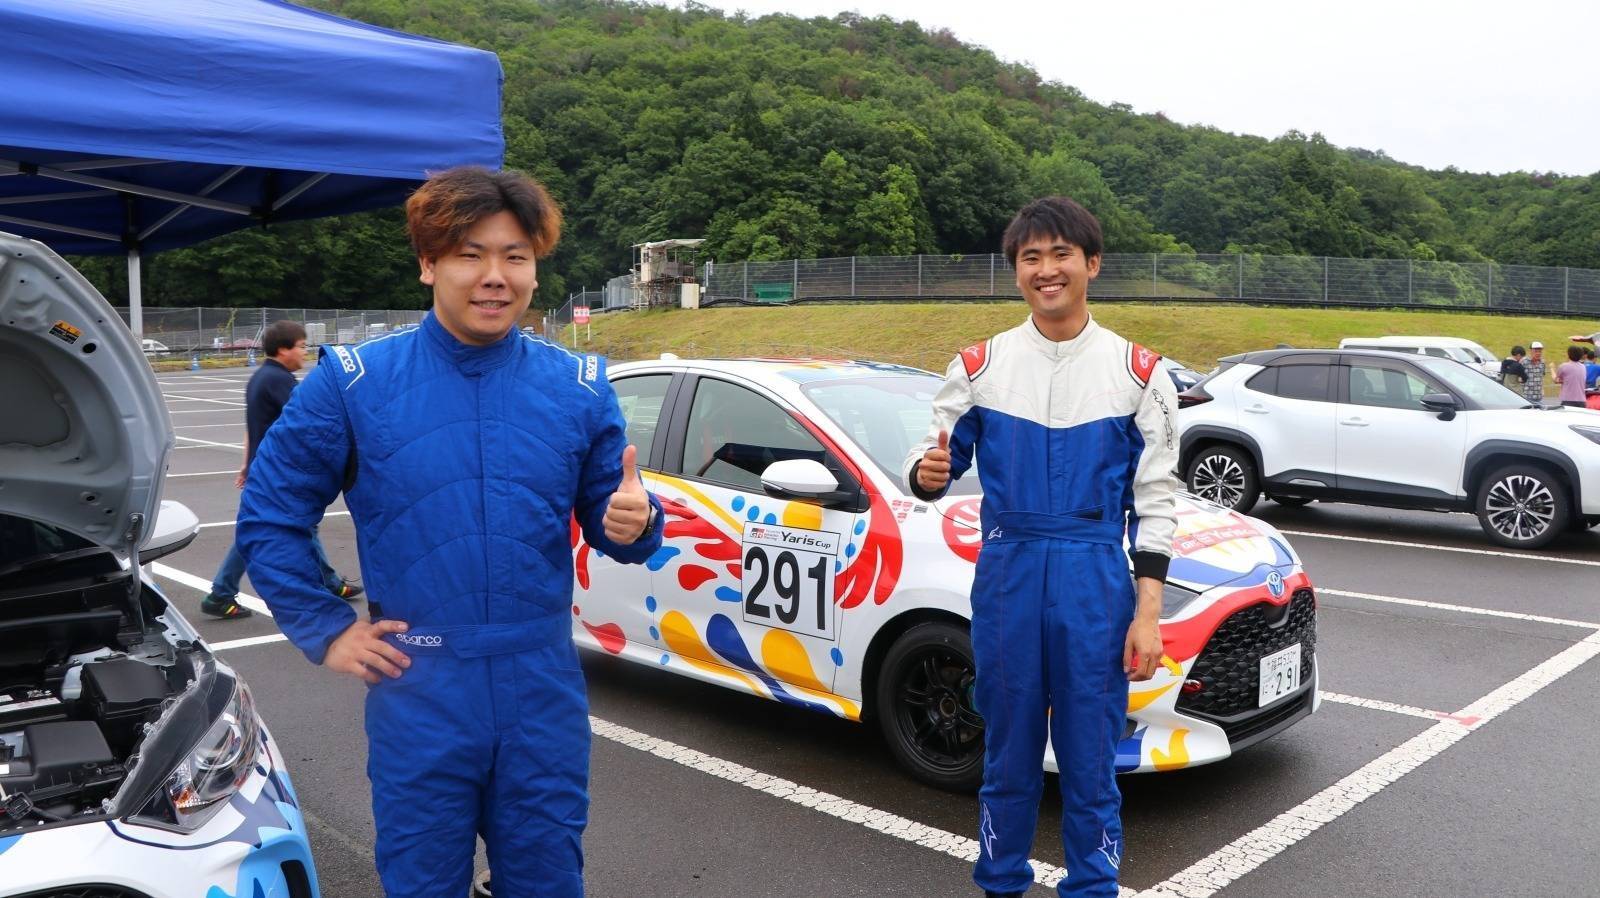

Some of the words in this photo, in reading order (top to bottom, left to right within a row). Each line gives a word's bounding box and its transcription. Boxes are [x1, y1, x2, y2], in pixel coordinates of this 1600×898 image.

[781, 531, 815, 546] Yaris
[815, 540, 831, 549] Cup
[744, 546, 828, 631] 291
